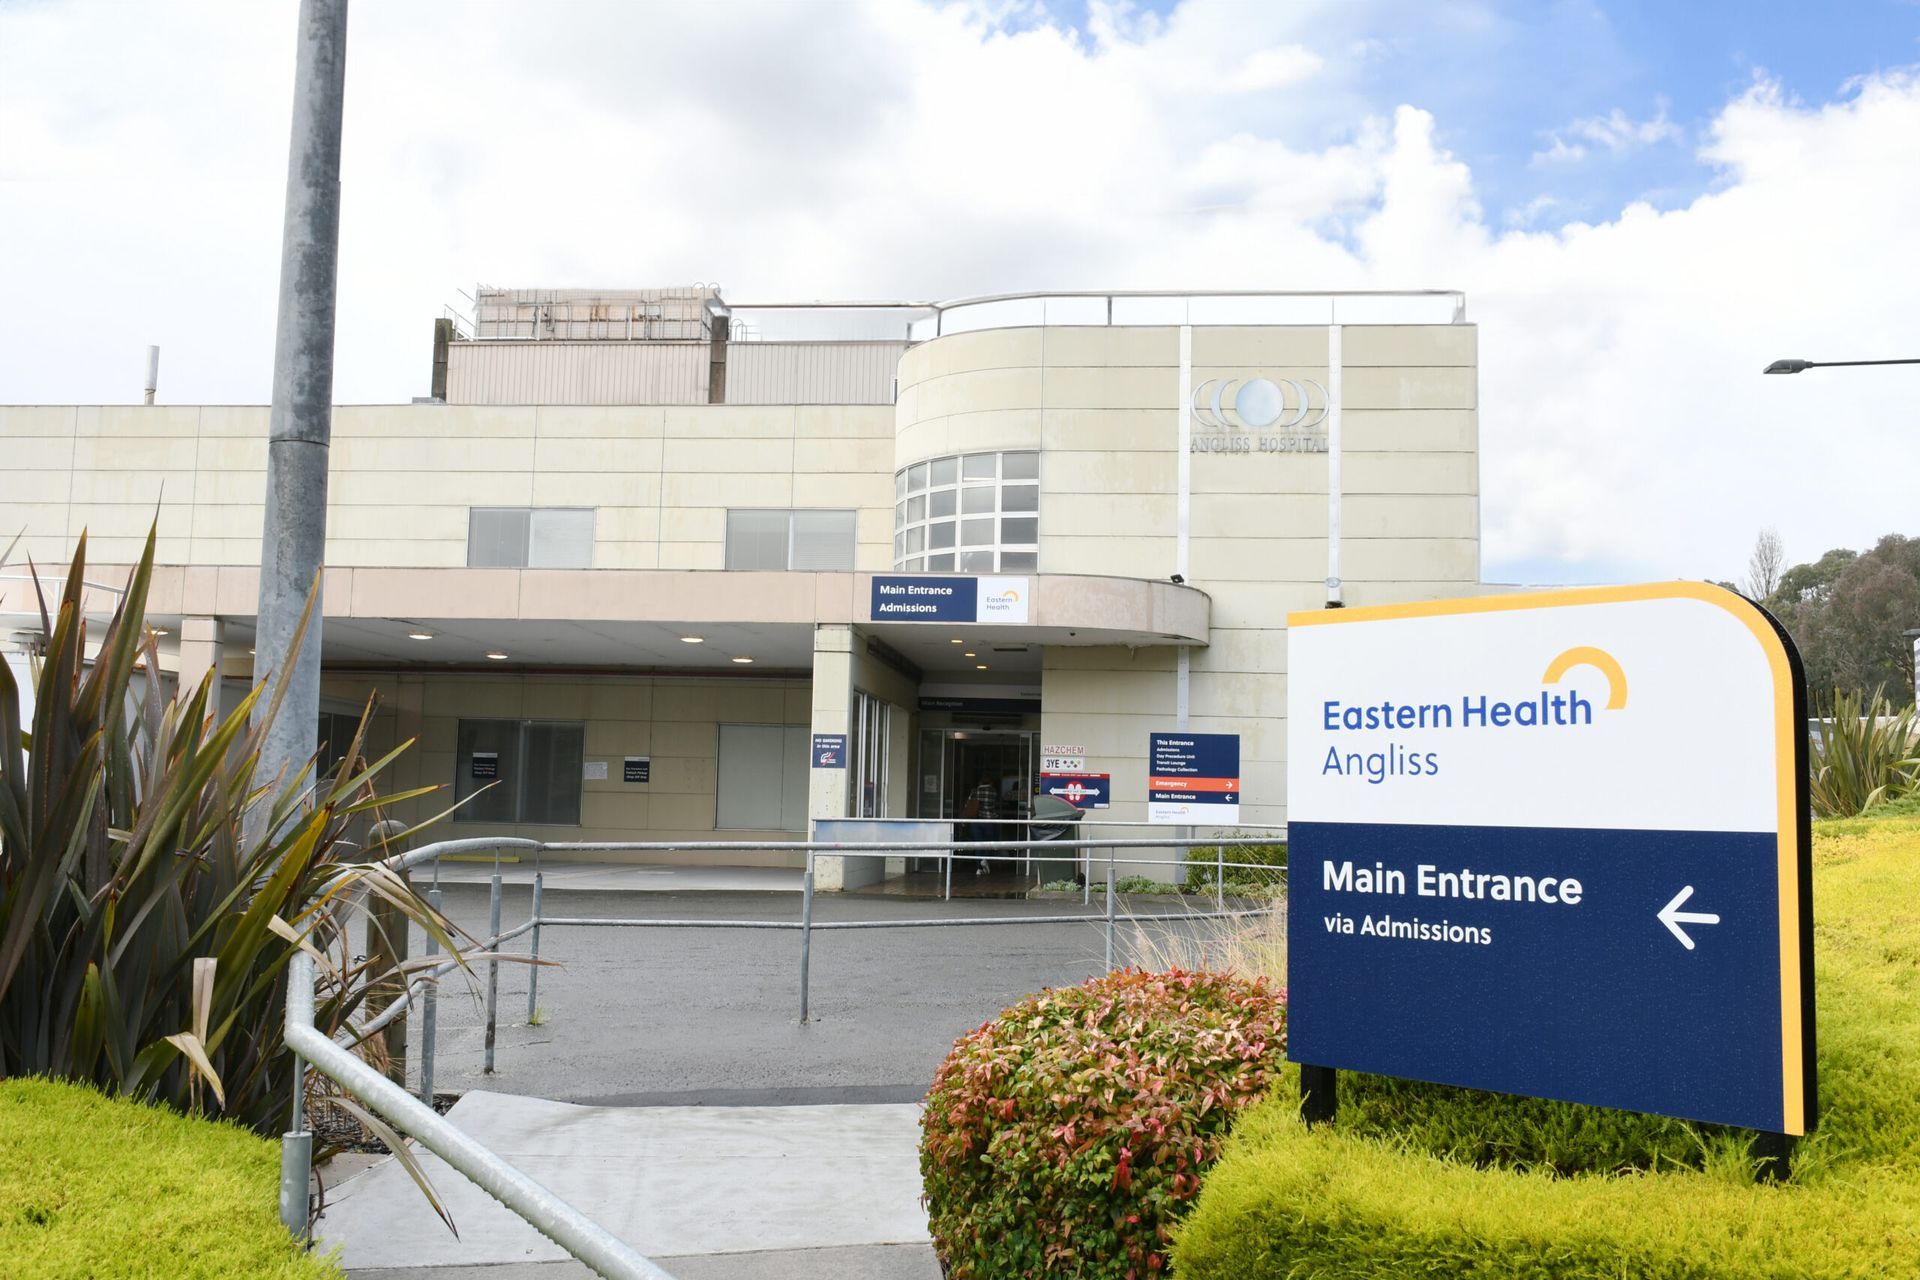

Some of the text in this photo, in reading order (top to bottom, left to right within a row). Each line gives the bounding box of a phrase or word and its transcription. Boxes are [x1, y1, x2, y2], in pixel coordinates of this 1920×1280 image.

[1190, 437, 1329, 453] ANGLISS HOSPITAL
[880, 585, 952, 596] Main Entrance
[879, 603, 937, 613] Admissions
[1323, 690, 1592, 731] Eastern Health
[1044, 745, 1084, 754] HAZCHEM
[1046, 759, 1060, 769] 3YE
[1322, 743, 1439, 784] Angliss
[1155, 780, 1188, 788] Emergency
[1323, 860, 1583, 904] Main Entrance
[1324, 913, 1492, 946] via Admissions
